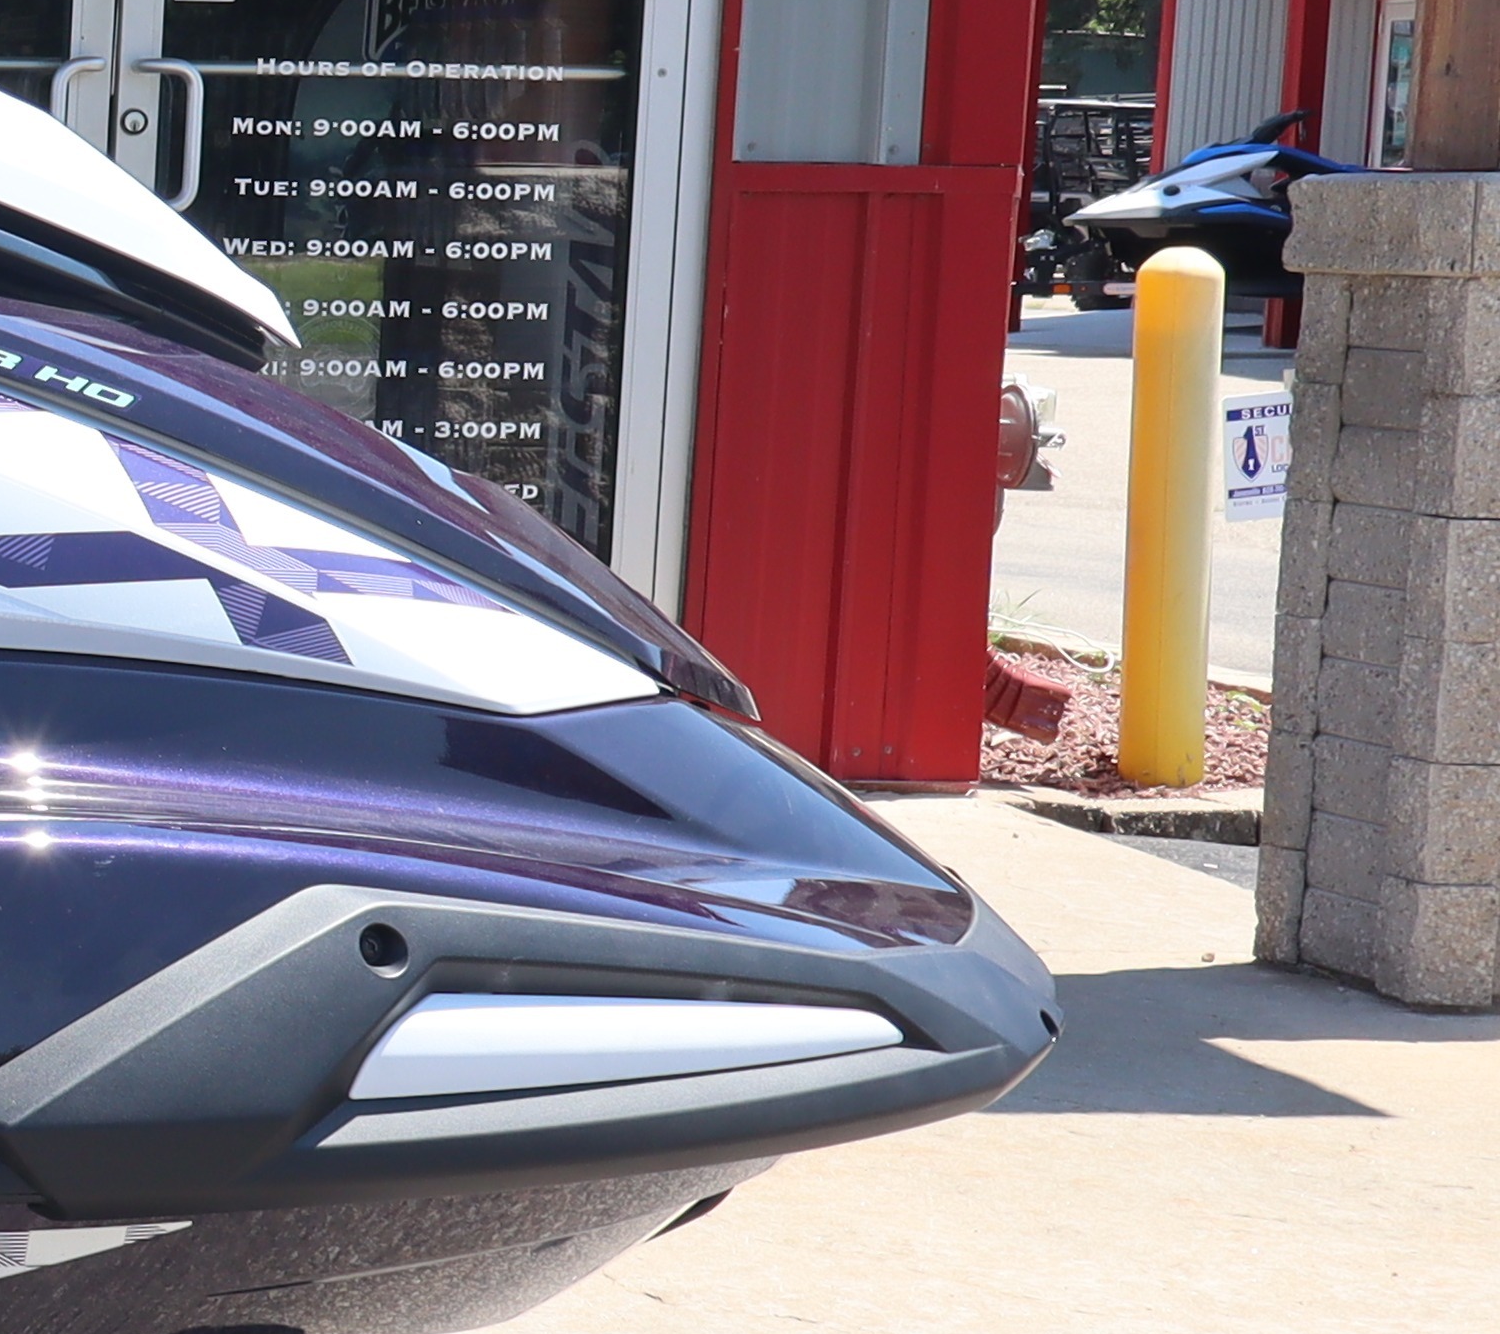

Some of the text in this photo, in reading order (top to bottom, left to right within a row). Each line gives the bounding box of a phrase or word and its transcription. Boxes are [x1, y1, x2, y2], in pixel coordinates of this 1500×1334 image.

[313, 118, 421, 139] 9:00AM
[452, 121, 560, 142] 6:00PM
[310, 179, 417, 199] 9:00AM
[449, 182, 556, 202] 6:00PM
[306, 239, 414, 259] 9:00AM
[445, 241, 552, 261] 6:00PM
[303, 299, 411, 318] 9:00AM
[441, 301, 548, 320] 6:00PM
[300, 359, 407, 378] 9:00AM
[438, 361, 545, 380] 6:00PM
[34, 366, 137, 408] HO
[434, 421, 541, 440] 3:00PM
